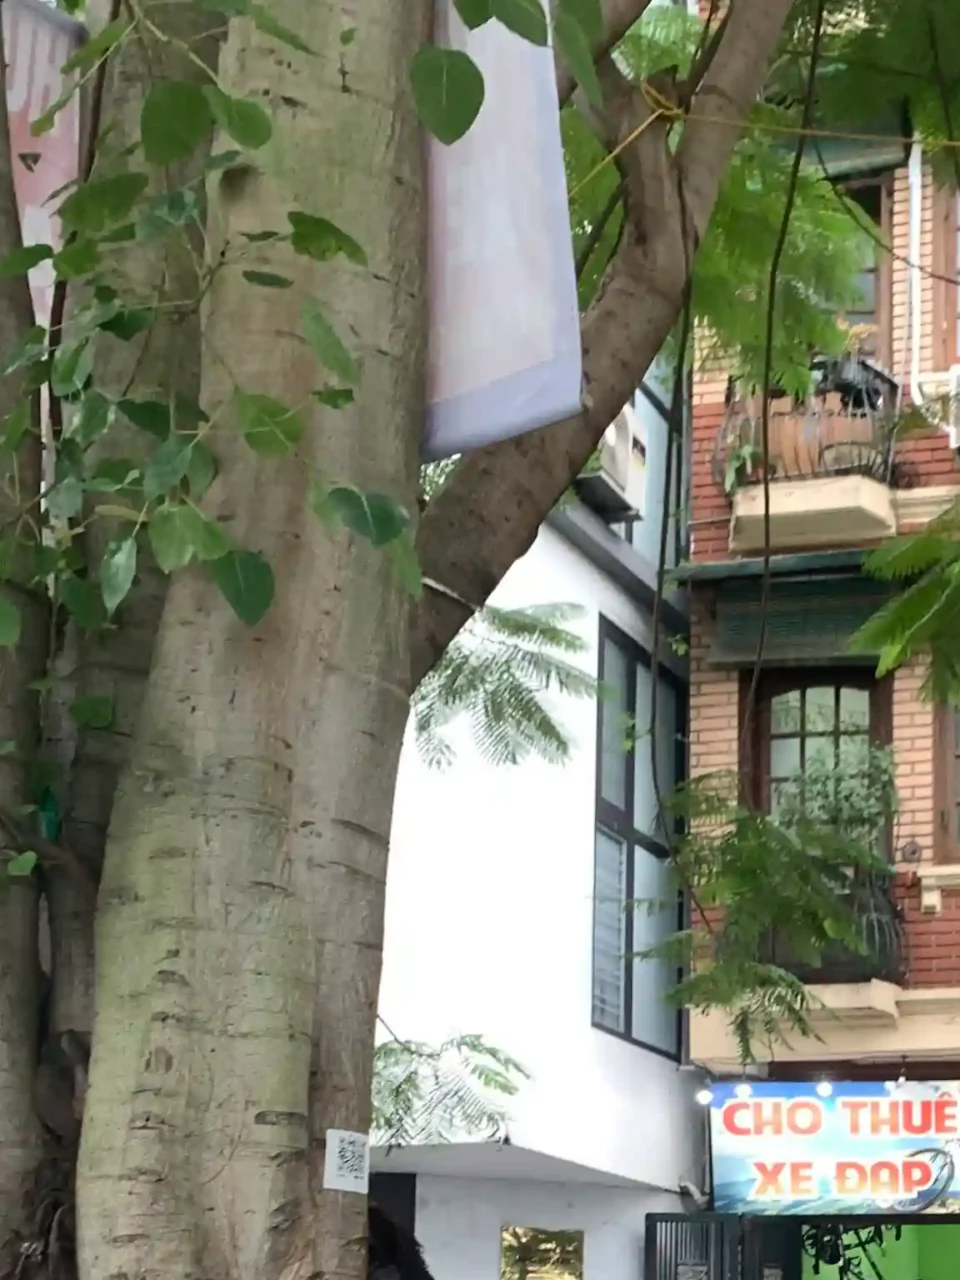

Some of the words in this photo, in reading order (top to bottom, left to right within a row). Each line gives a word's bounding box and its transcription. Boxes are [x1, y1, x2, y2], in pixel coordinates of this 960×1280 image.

[722, 1101, 822, 1136] CHO
[841, 1091, 958, 1136] THUÊ
[753, 1161, 814, 1196] XE
